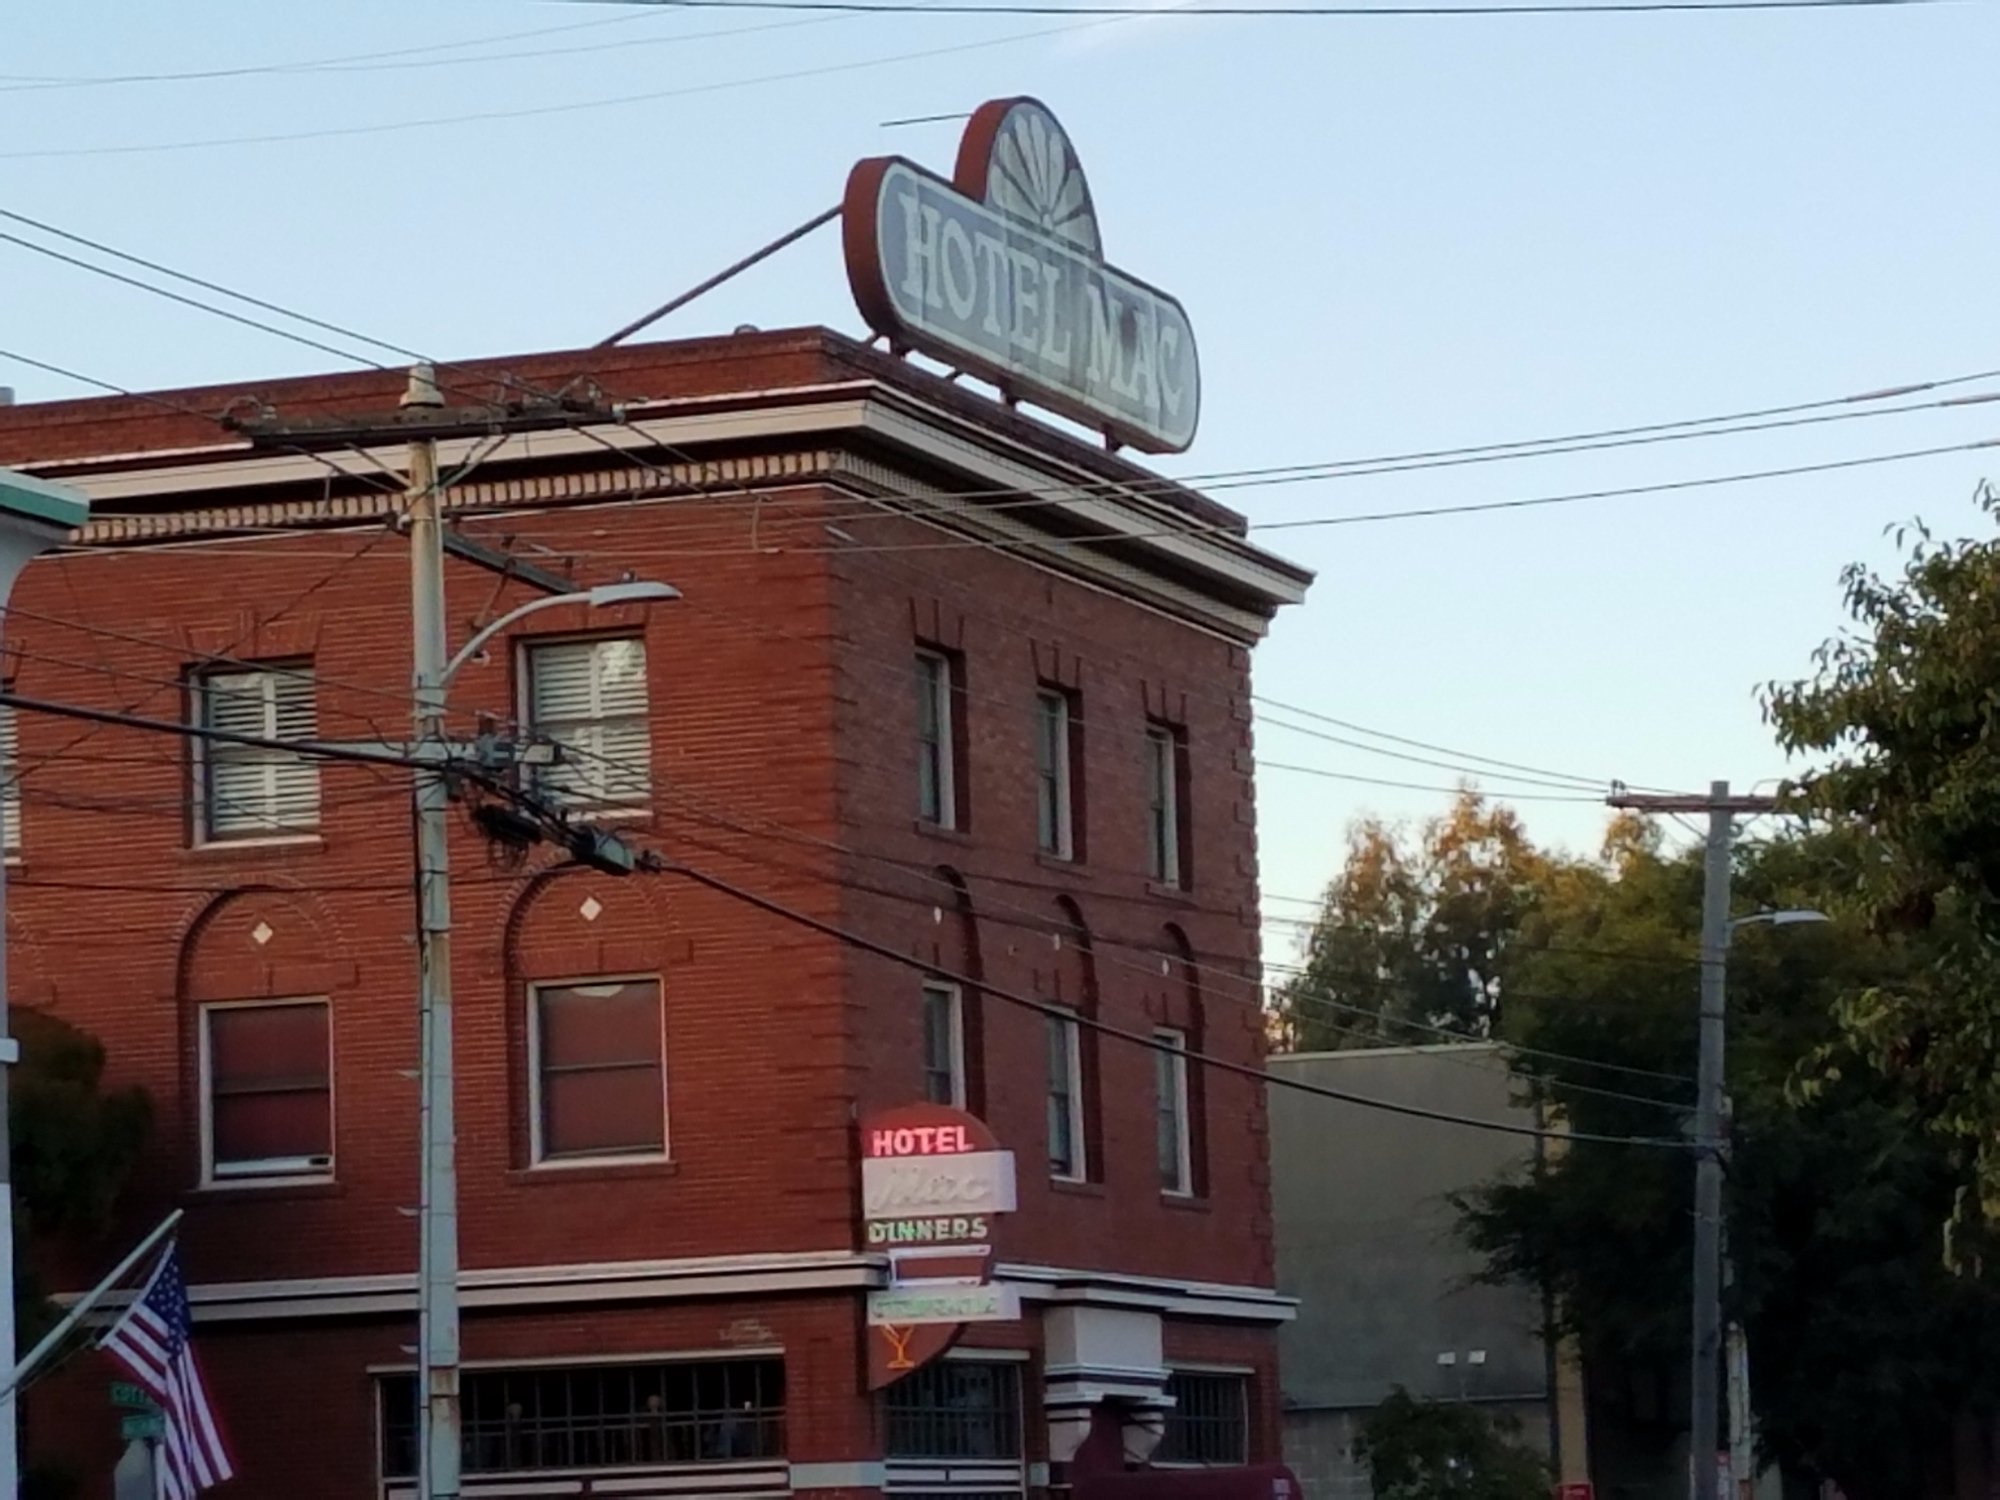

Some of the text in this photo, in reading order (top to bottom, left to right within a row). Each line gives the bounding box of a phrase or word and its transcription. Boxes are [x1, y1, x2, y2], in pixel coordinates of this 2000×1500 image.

[898, 192, 1183, 417] HOTEL MAC
[873, 1126, 975, 1156] HOTEL
[868, 1217, 988, 1243] DINNERS
